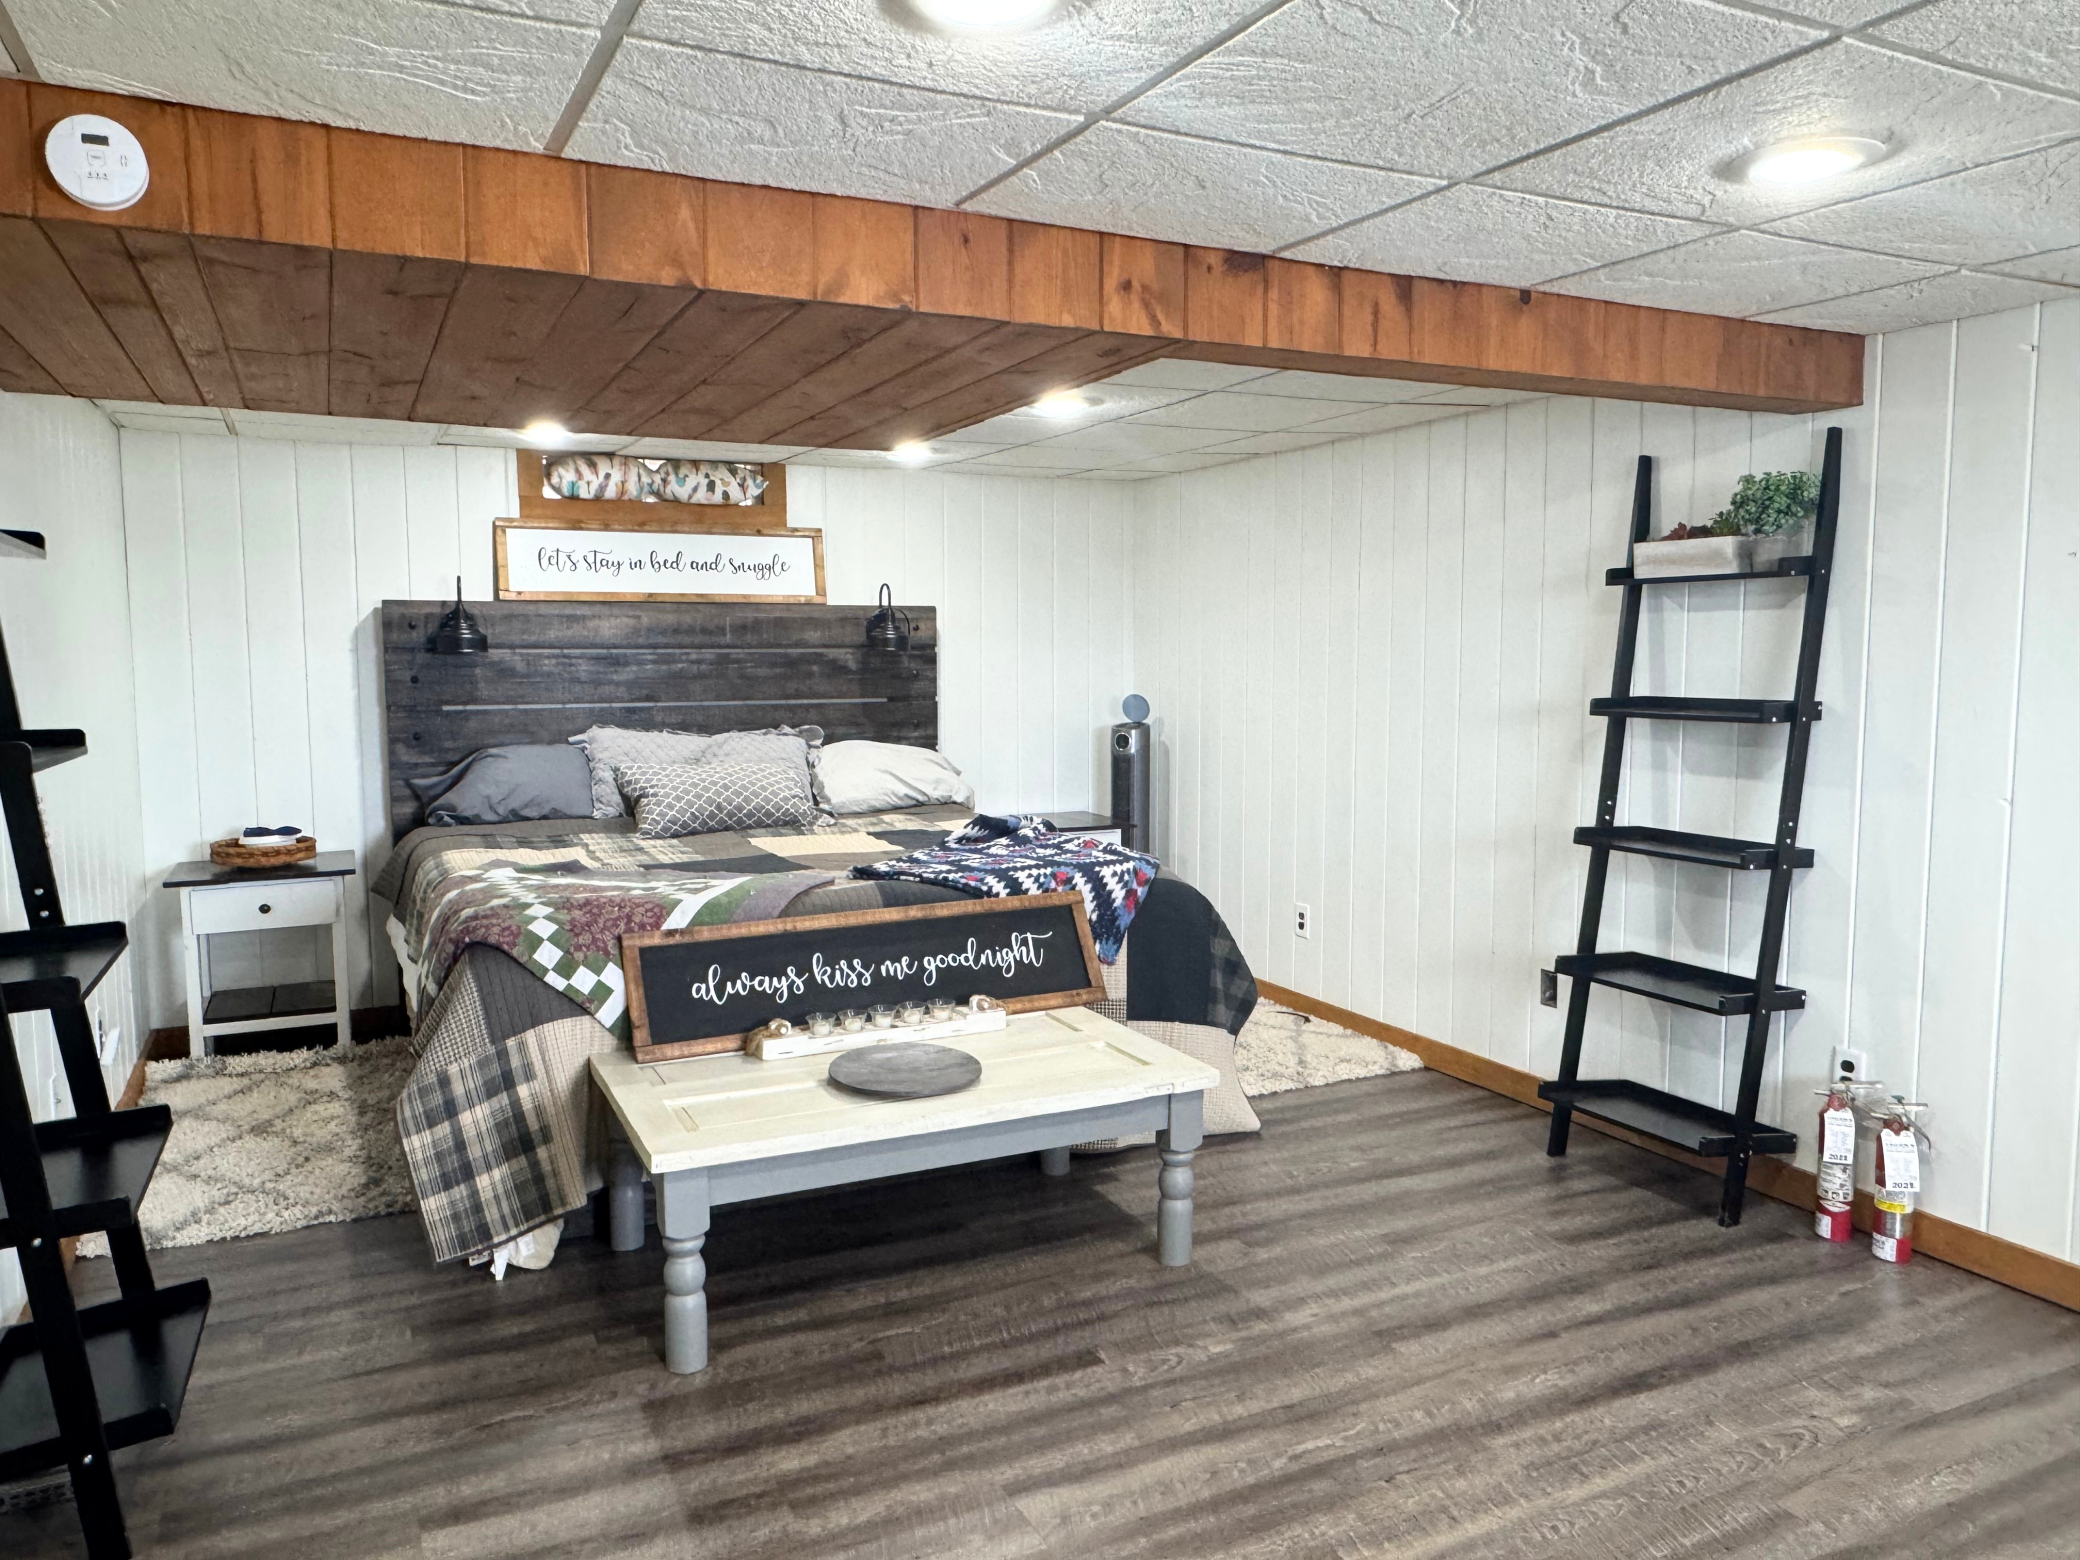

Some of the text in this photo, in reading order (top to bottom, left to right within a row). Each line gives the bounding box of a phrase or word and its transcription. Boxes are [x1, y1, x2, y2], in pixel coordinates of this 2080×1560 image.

[537, 546, 791, 581] let's stay in bed and snuggle
[691, 931, 1053, 1006] always kiss me goodnight
